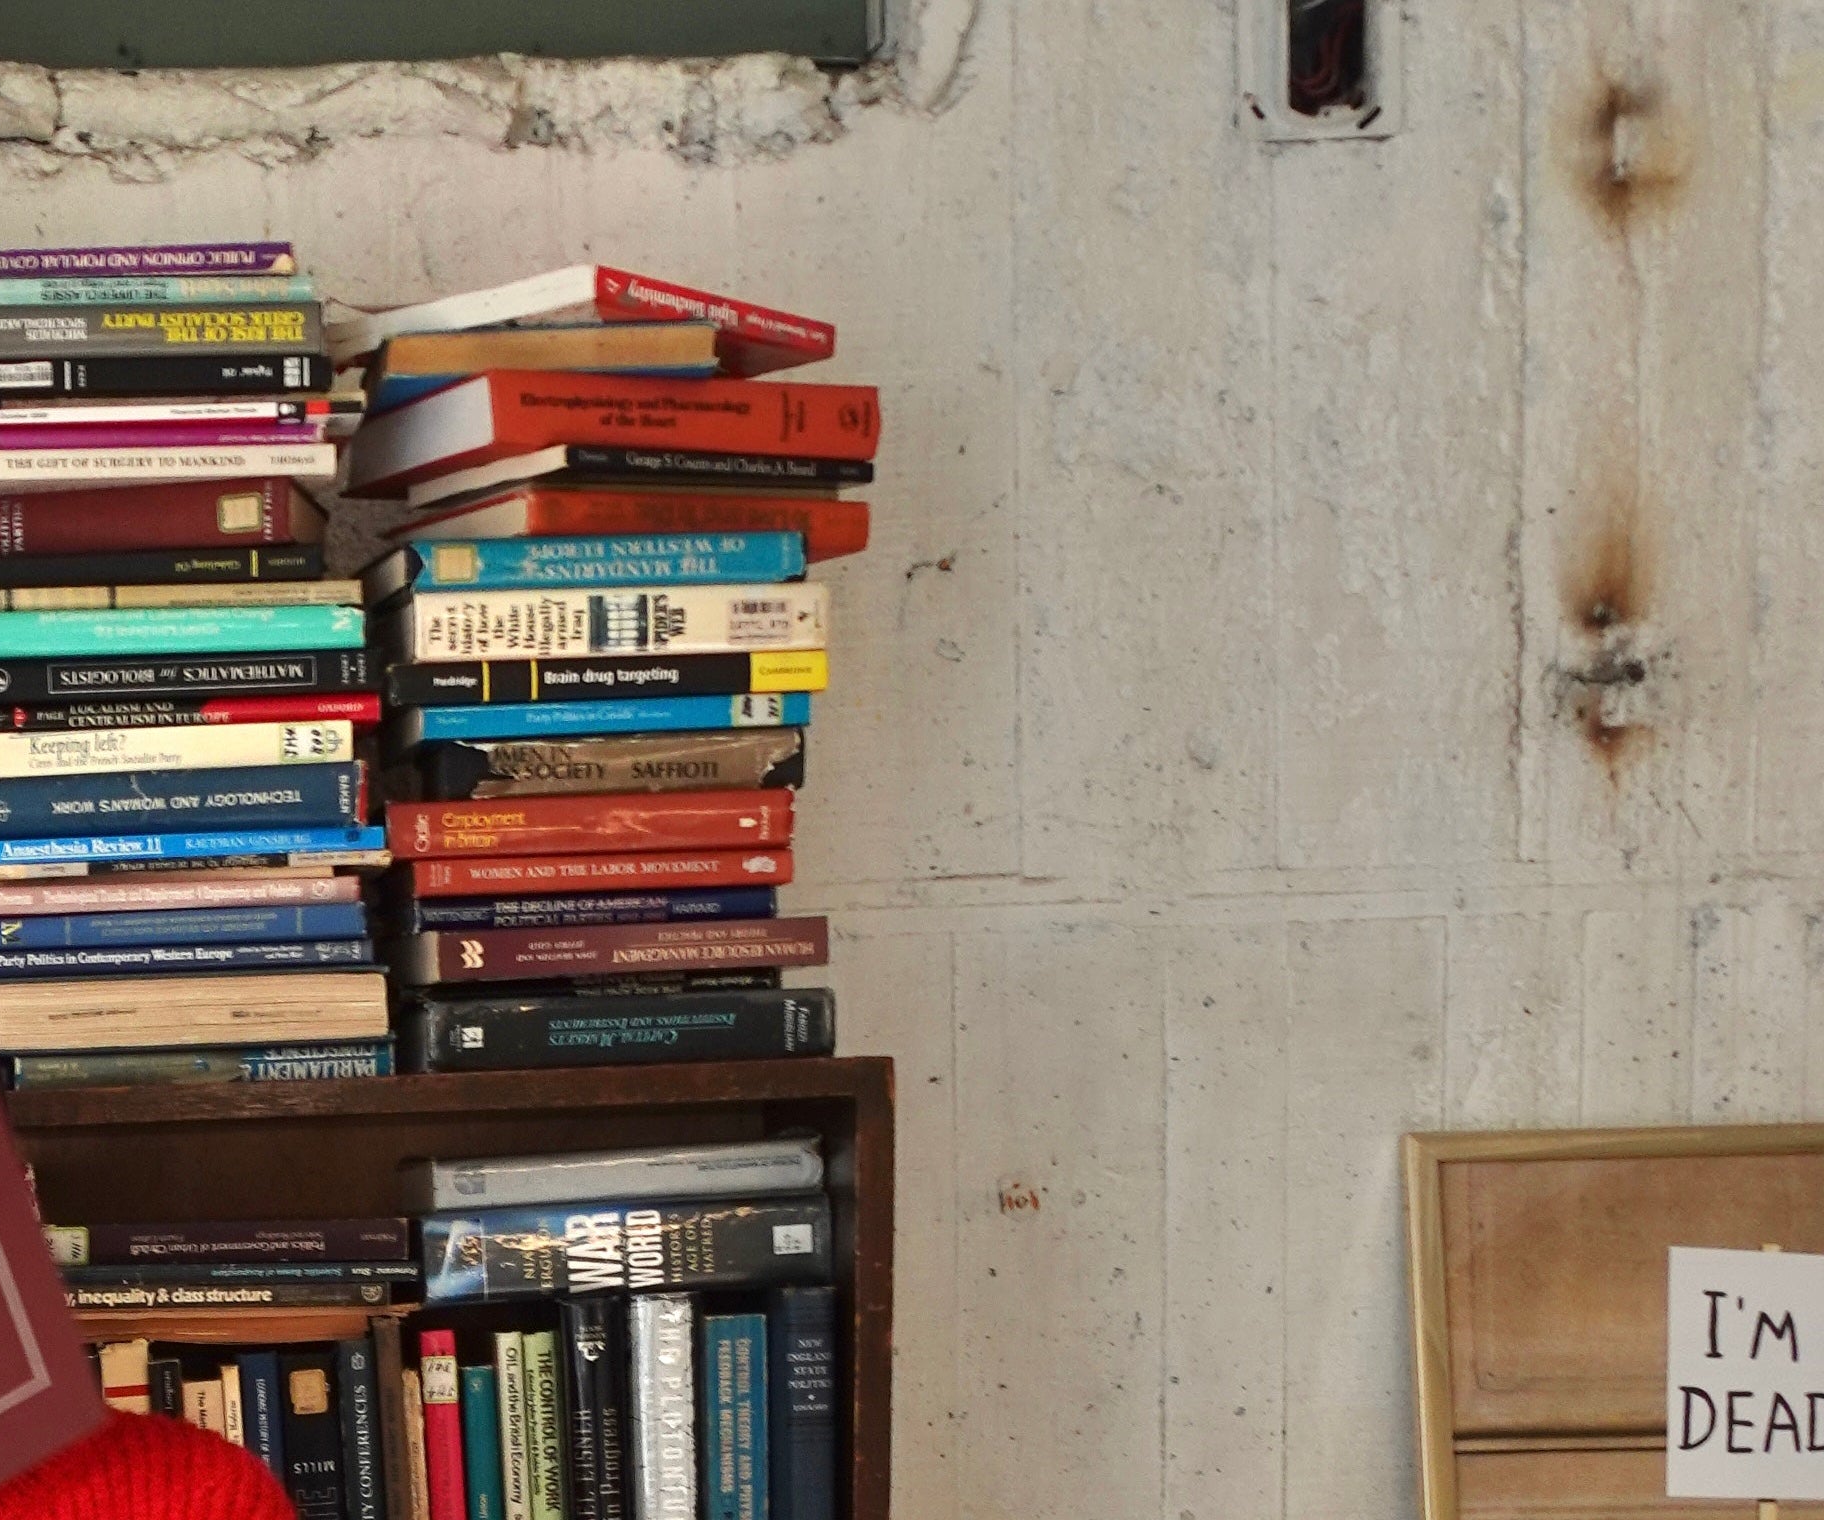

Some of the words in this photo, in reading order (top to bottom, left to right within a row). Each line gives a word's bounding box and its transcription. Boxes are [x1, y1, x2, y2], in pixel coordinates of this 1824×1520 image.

[41, 252, 106, 269] POPULAR
[106, 251, 141, 268] AND
[143, 251, 204, 268] OPINION
[203, 249, 257, 266] PUBLIC
[626, 278, 707, 320] Biochemistry
[101, 311, 154, 329] PARTY
[157, 311, 253, 328] SOCIALIST
[255, 311, 305, 327] GREEK
[165, 325, 198, 342] THE
[202, 325, 226, 341] OF
[229, 325, 273, 341] RISE
[275, 325, 305, 340] THE
[4, 457, 33, 469] THE
[70, 456, 89, 468] OF
[178, 455, 246, 467] MANKIND
[626, 451, 663, 470] George
[526, 541, 607, 559] EUROPE
[613, 537, 714, 556] WESTERN
[718, 537, 747, 553] OF
[550, 558, 674, 579] MANDARINS
[679, 557, 720, 575] THE
[427, 617, 443, 645] The
[492, 615, 505, 640] the
[555, 601, 568, 651] armed
[669, 607, 686, 637] WEB
[59, 667, 156, 686] BIOLOGISTS
[159, 667, 177, 679] for
[182, 662, 304, 681] MATHEMATICS
[543, 670, 581, 687] Brain
[581, 669, 615, 688] drug
[616, 667, 680, 688] targeting
[67, 713, 155, 727] CENTRALISM
[27, 735, 91, 757] Keeping
[92, 733, 128, 753] left?
[524, 762, 608, 780] SOCIETY
[170, 795, 201, 809] AND
[205, 789, 303, 808] TECHNOLOGY
[338, 773, 351, 815] BAKER
[51, 799, 96, 815] WORK
[98, 796, 168, 813] WOMAN'S
[441, 812, 526, 831] Employment
[0, 840, 89, 857] Anaesthesia
[90, 838, 144, 855] Review
[457, 832, 499, 849] Britain
[469, 865, 524, 879] WOMEN
[526, 864, 557, 878] AND
[559, 862, 585, 876] THE
[589, 861, 637, 875] LABOR
[640, 859, 720, 875] MOVEMENT
[521, 898, 575, 913] DECLINE
[594, 896, 669, 911] AMERICAN
[26, 952, 65, 968] Politics
[66, 952, 77, 965] in
[78, 949, 151, 967] Contemporary
[151, 948, 194, 962] Western
[194, 947, 233, 963] Europe
[610, 947, 700, 963] MANAGEMENT
[702, 945, 763, 960] RESOURCE
[764, 942, 815, 957] HUMAN
[548, 1031, 617, 1048] MARKETS
[253, 1057, 376, 1079] PARLIAMENT
[565, 1211, 625, 1295] WAR
[625, 1208, 666, 1290] WORLD
[77, 1287, 157, 1307] inequality
[155, 1289, 171, 1305] &
[170, 1288, 205, 1304] class
[205, 1287, 273, 1304] structure
[1701, 1289, 1798, 1363] I'M
[797, 1338, 823, 1349] NEW
[505, 1346, 518, 1368] OIL
[538, 1350, 552, 1380] THE
[735, 1337, 751, 1394] CONTROL
[786, 1352, 833, 1363] ENGLAND
[717, 1339, 733, 1404] FEEDBACK
[792, 1365, 828, 1375] STATE
[507, 1369, 518, 1391] and
[508, 1390, 519, 1409] the
[541, 1380, 557, 1435] CONTROL
[510, 1409, 521, 1445] British
[737, 1400, 752, 1450] THEORY
[353, 1383, 377, 1499] CONFERENCES
[546, 1436, 559, 1453] OF
[576, 1410, 593, 1483] EISNER
[599, 1408, 621, 1496] Progress
[719, 1409, 735, 1493] MECHANISMS
[293, 1459, 335, 1475] MILLS
[511, 1447, 523, 1504] Economy
[738, 1454, 752, 1481] AND
[548, 1455, 561, 1512] WORK
